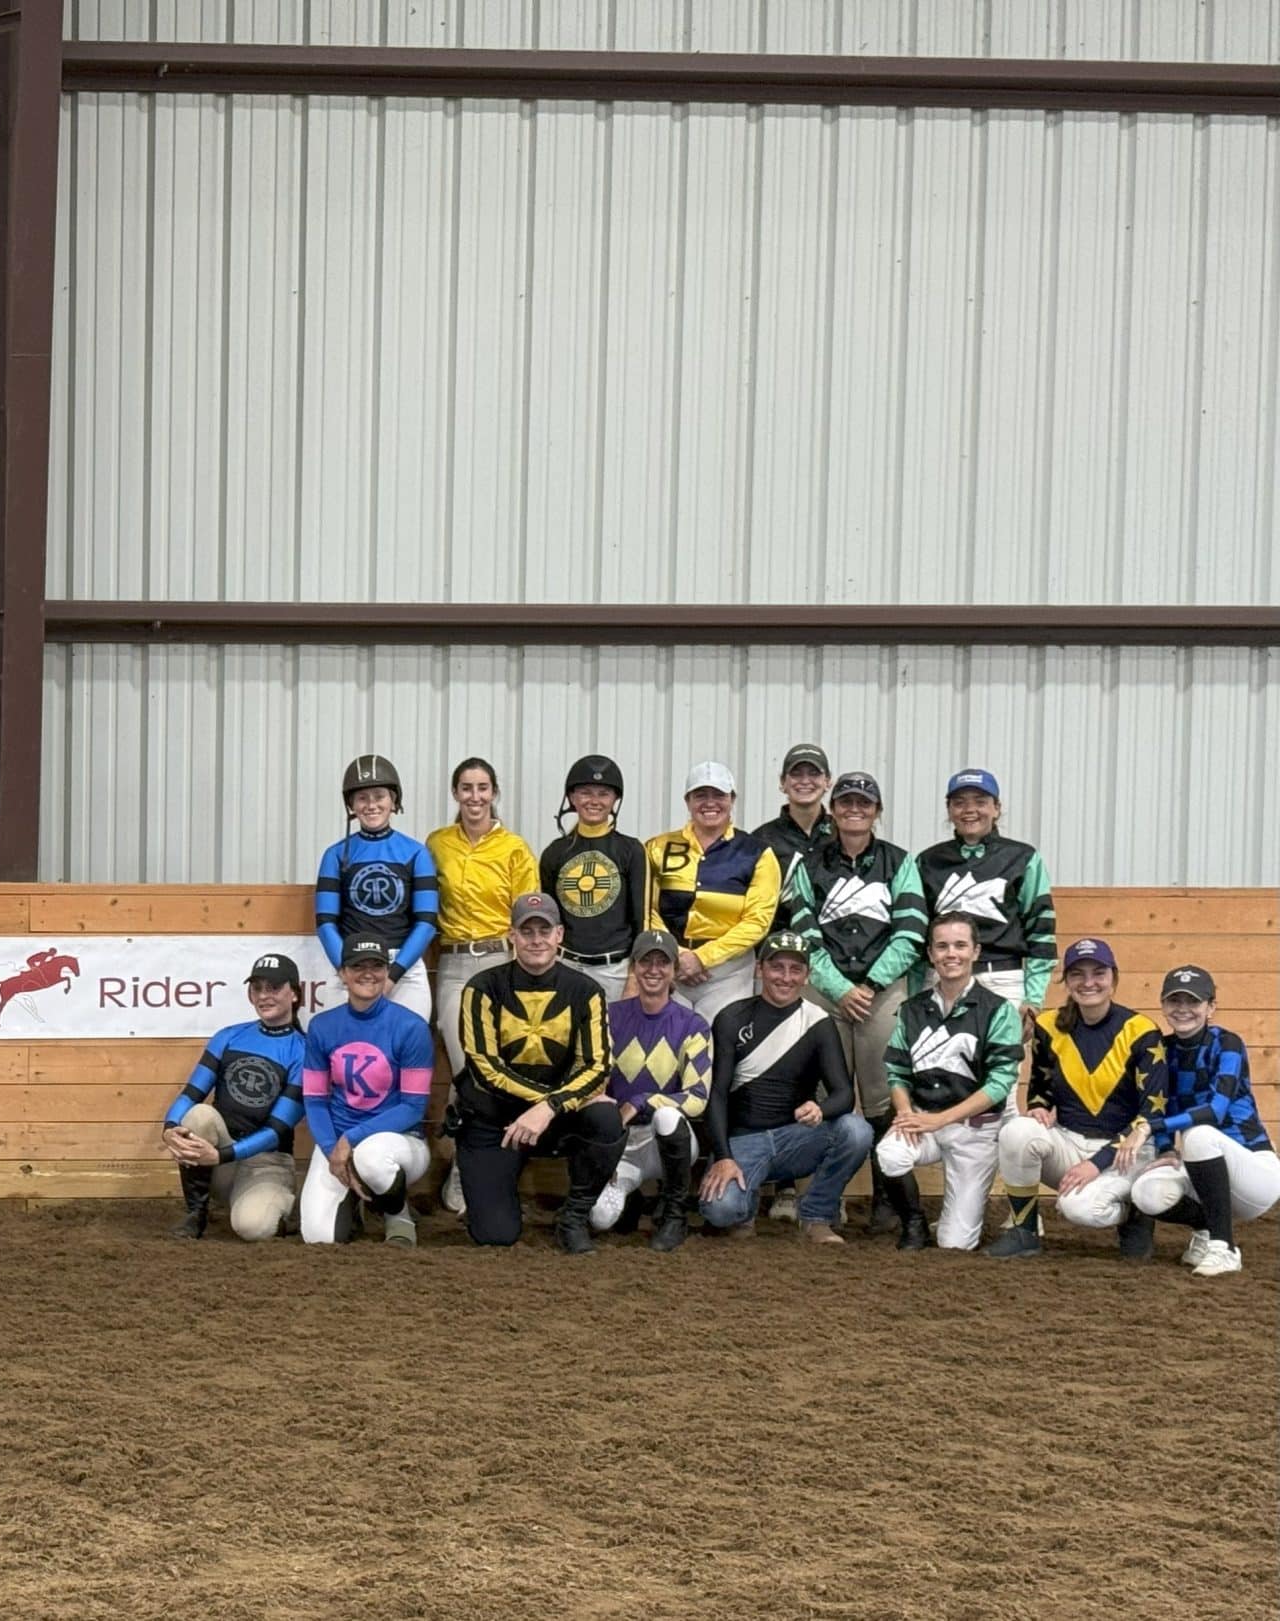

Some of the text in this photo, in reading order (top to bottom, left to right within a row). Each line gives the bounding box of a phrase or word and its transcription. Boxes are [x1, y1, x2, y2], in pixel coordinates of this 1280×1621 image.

[663, 842, 691, 873] B
[99, 976, 228, 1009] Rider
[342, 1054, 380, 1098] K
